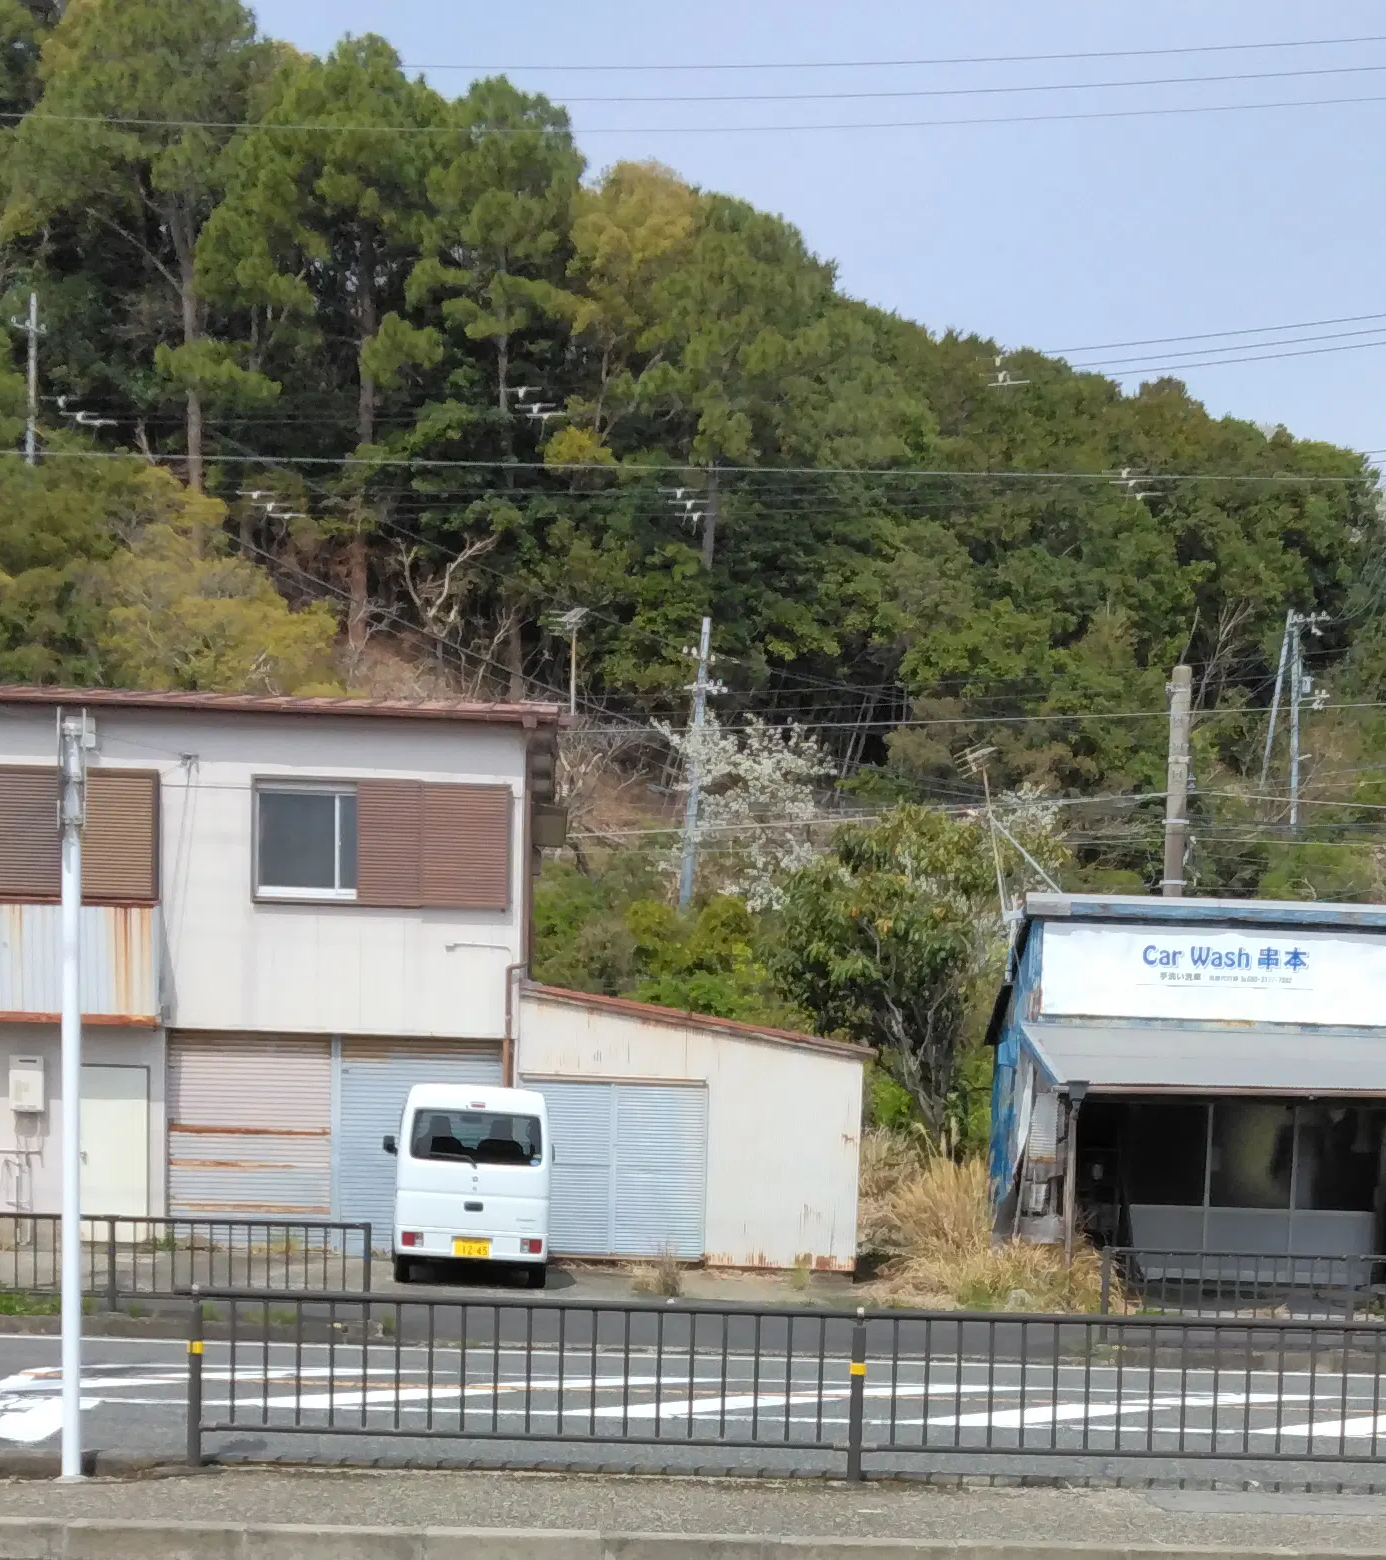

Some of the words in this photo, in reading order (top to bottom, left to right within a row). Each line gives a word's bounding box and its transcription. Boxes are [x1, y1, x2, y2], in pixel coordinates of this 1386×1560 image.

[1143, 945, 1182, 966] Car
[1190, 946, 1251, 968] Wash
[1257, 946, 1309, 971] 串本
